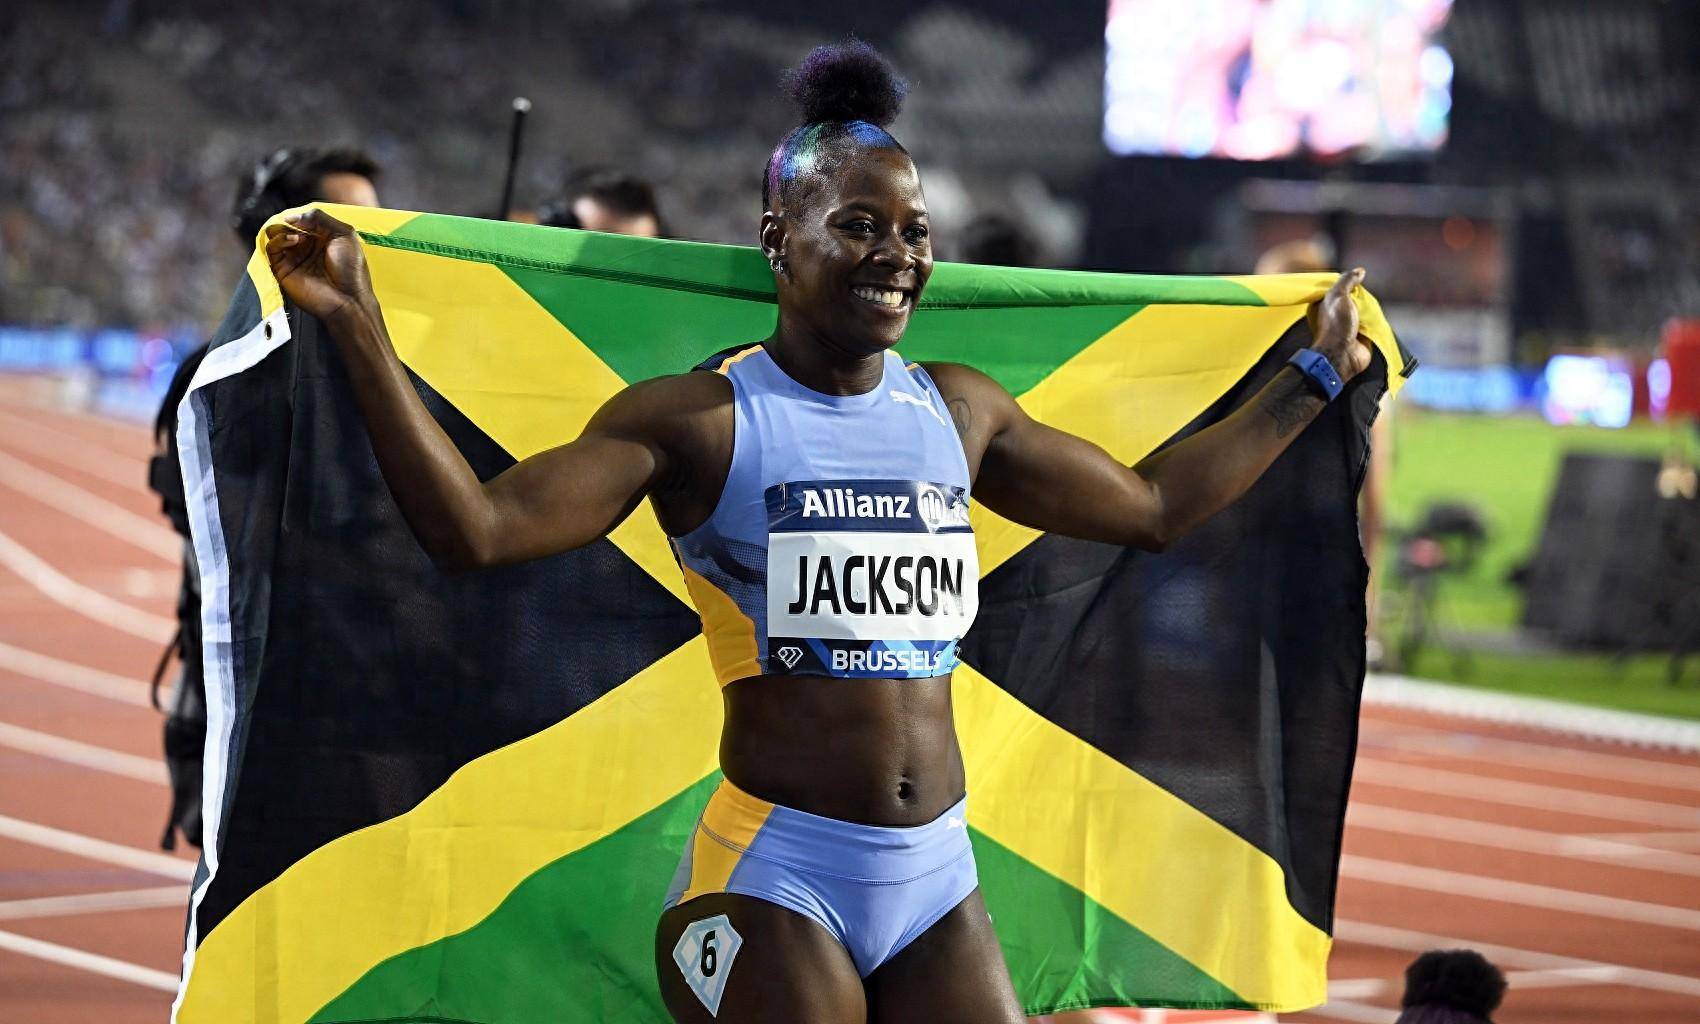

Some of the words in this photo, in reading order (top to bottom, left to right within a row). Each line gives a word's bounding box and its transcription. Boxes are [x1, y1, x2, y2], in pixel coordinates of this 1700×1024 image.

[802, 488, 912, 518] Allianz
[788, 555, 964, 616] JACKSON
[700, 930, 717, 977] 6
